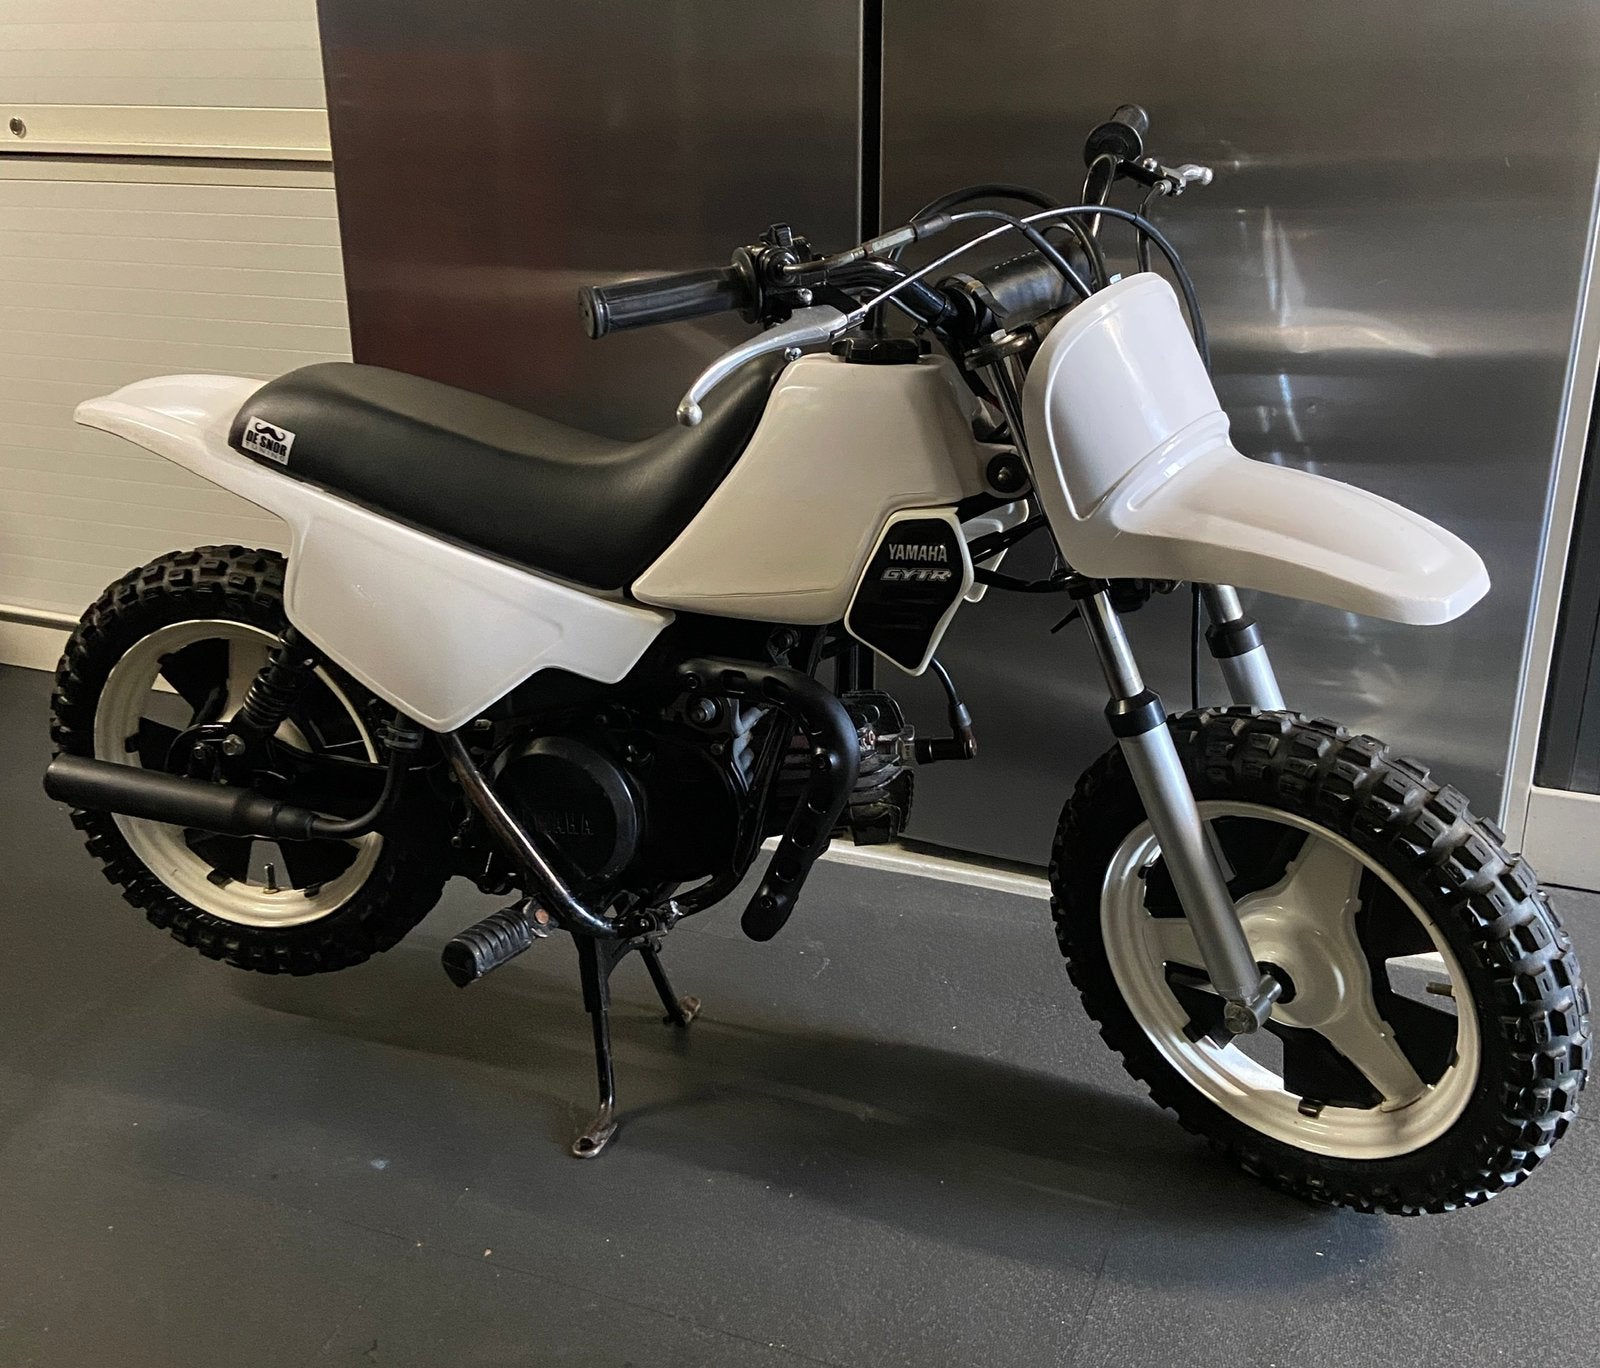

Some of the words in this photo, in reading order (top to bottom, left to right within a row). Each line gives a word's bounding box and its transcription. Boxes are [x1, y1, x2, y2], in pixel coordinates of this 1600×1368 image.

[246, 430, 259, 444] DE
[259, 436, 287, 456] SNOR
[889, 544, 948, 562] YAMAHA
[880, 567, 952, 582] GYTR
